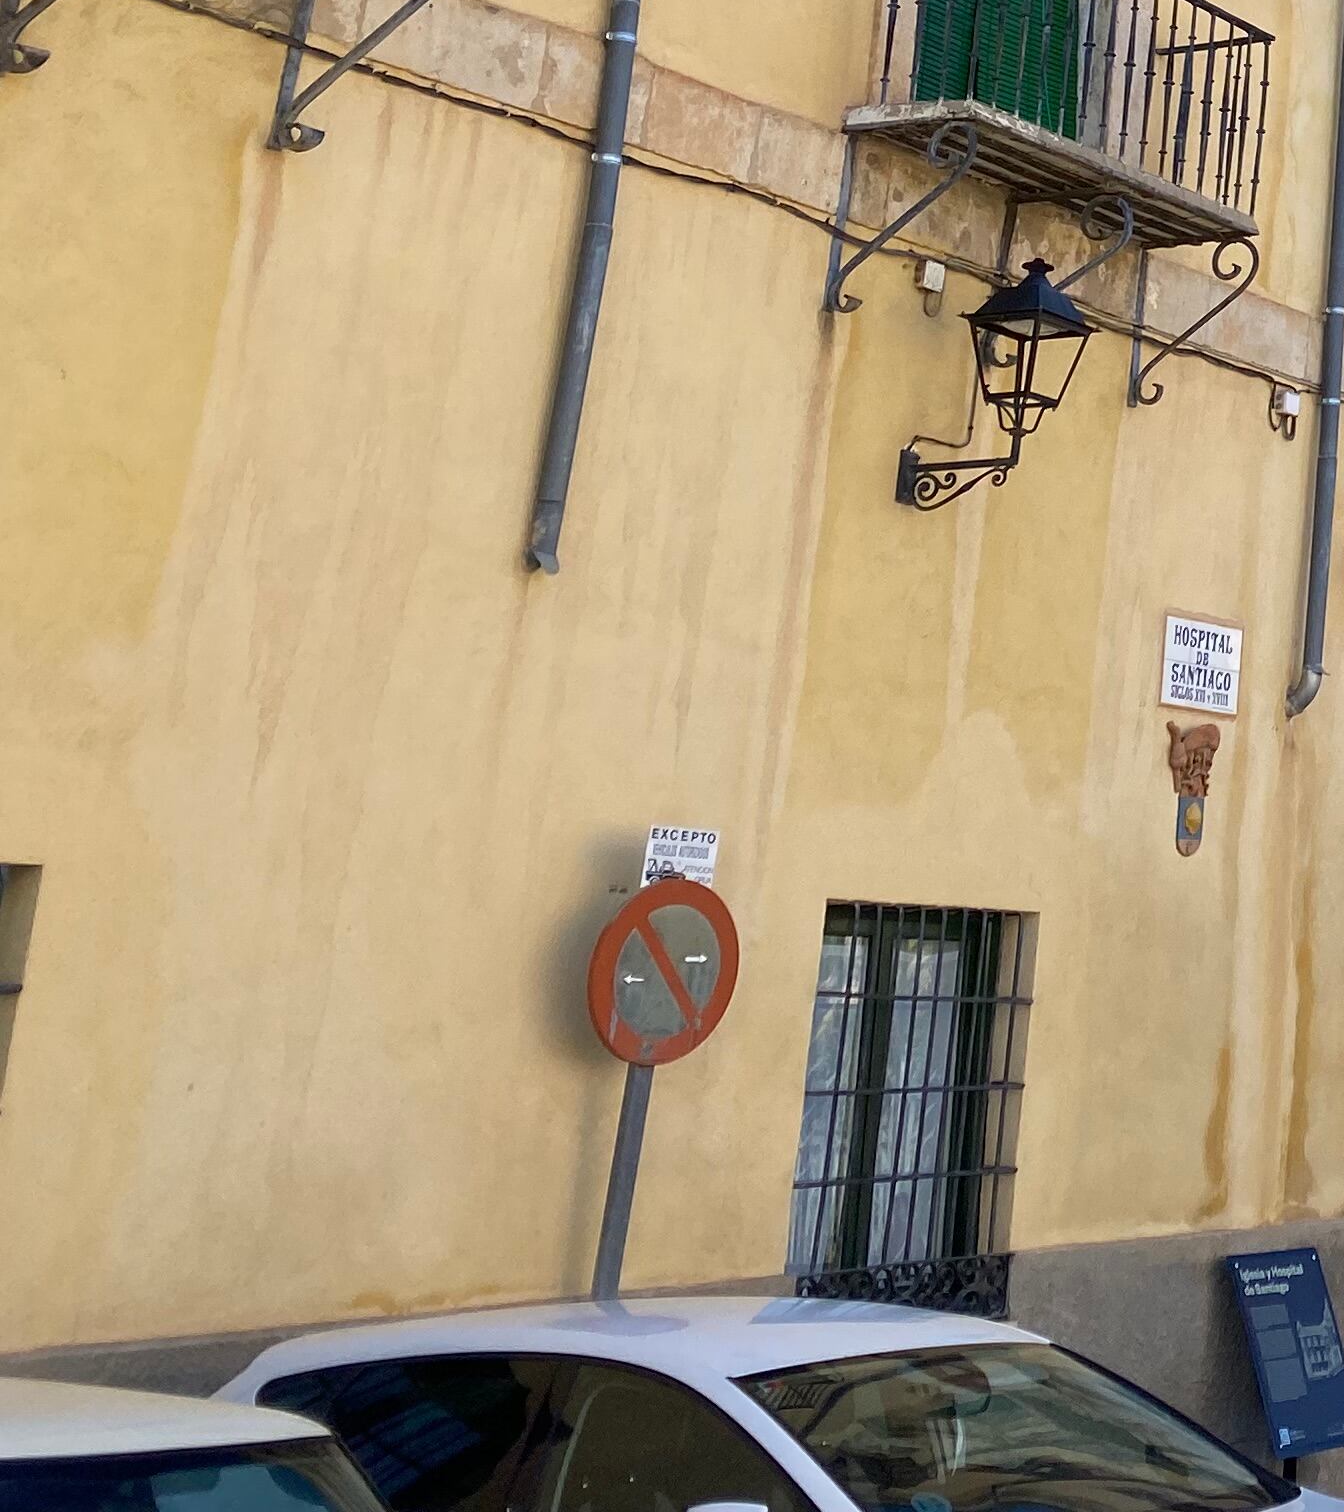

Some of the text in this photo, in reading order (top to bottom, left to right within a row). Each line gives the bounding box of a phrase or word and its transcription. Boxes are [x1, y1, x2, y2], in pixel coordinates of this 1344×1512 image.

[1174, 625, 1233, 654] HOSPITAL
[1196, 650, 1209, 666] DE
[1171, 663, 1231, 691] SANTIAGO
[651, 828, 717, 844] EXCEPTO
[1240, 1268, 1265, 1283] Iglesia
[1270, 1263, 1304, 1279] Hospital
[1244, 1282, 1290, 1296] de Santiago
